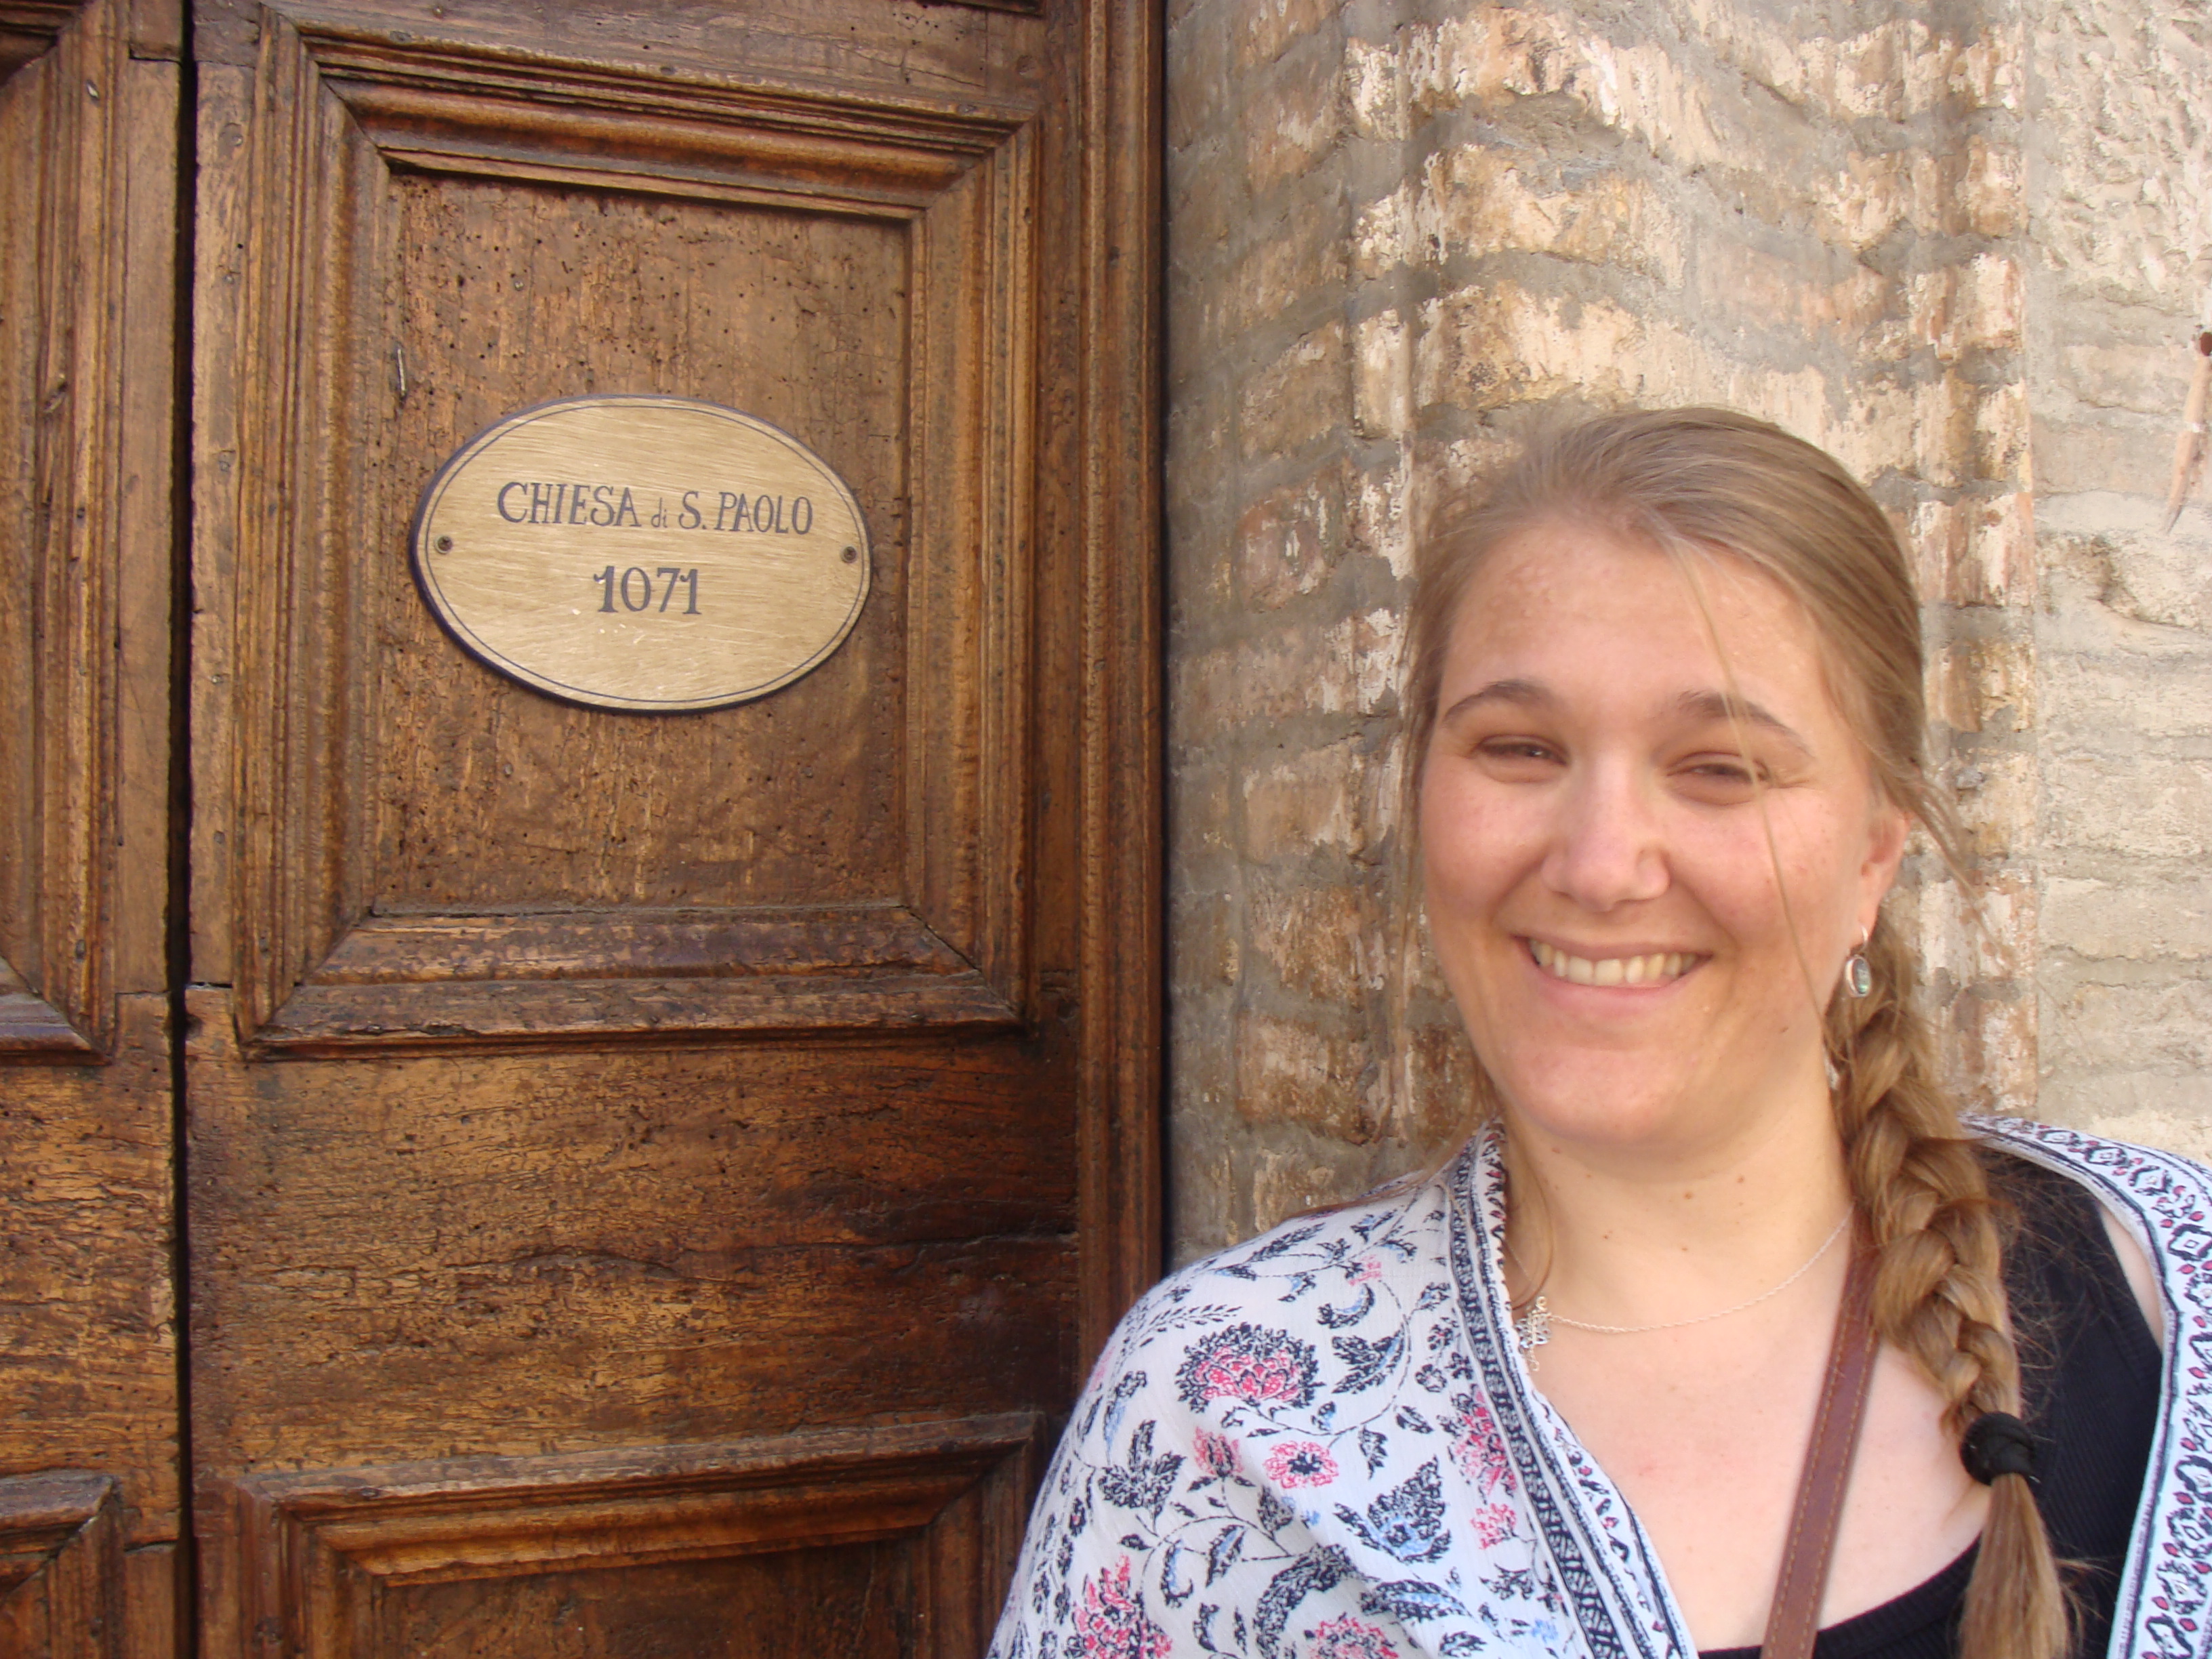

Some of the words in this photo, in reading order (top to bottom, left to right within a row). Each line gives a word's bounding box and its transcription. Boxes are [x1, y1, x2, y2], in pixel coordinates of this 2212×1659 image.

[497, 481, 642, 527] CHIESA
[651, 497, 668, 529] di
[594, 565, 701, 615] 1071
